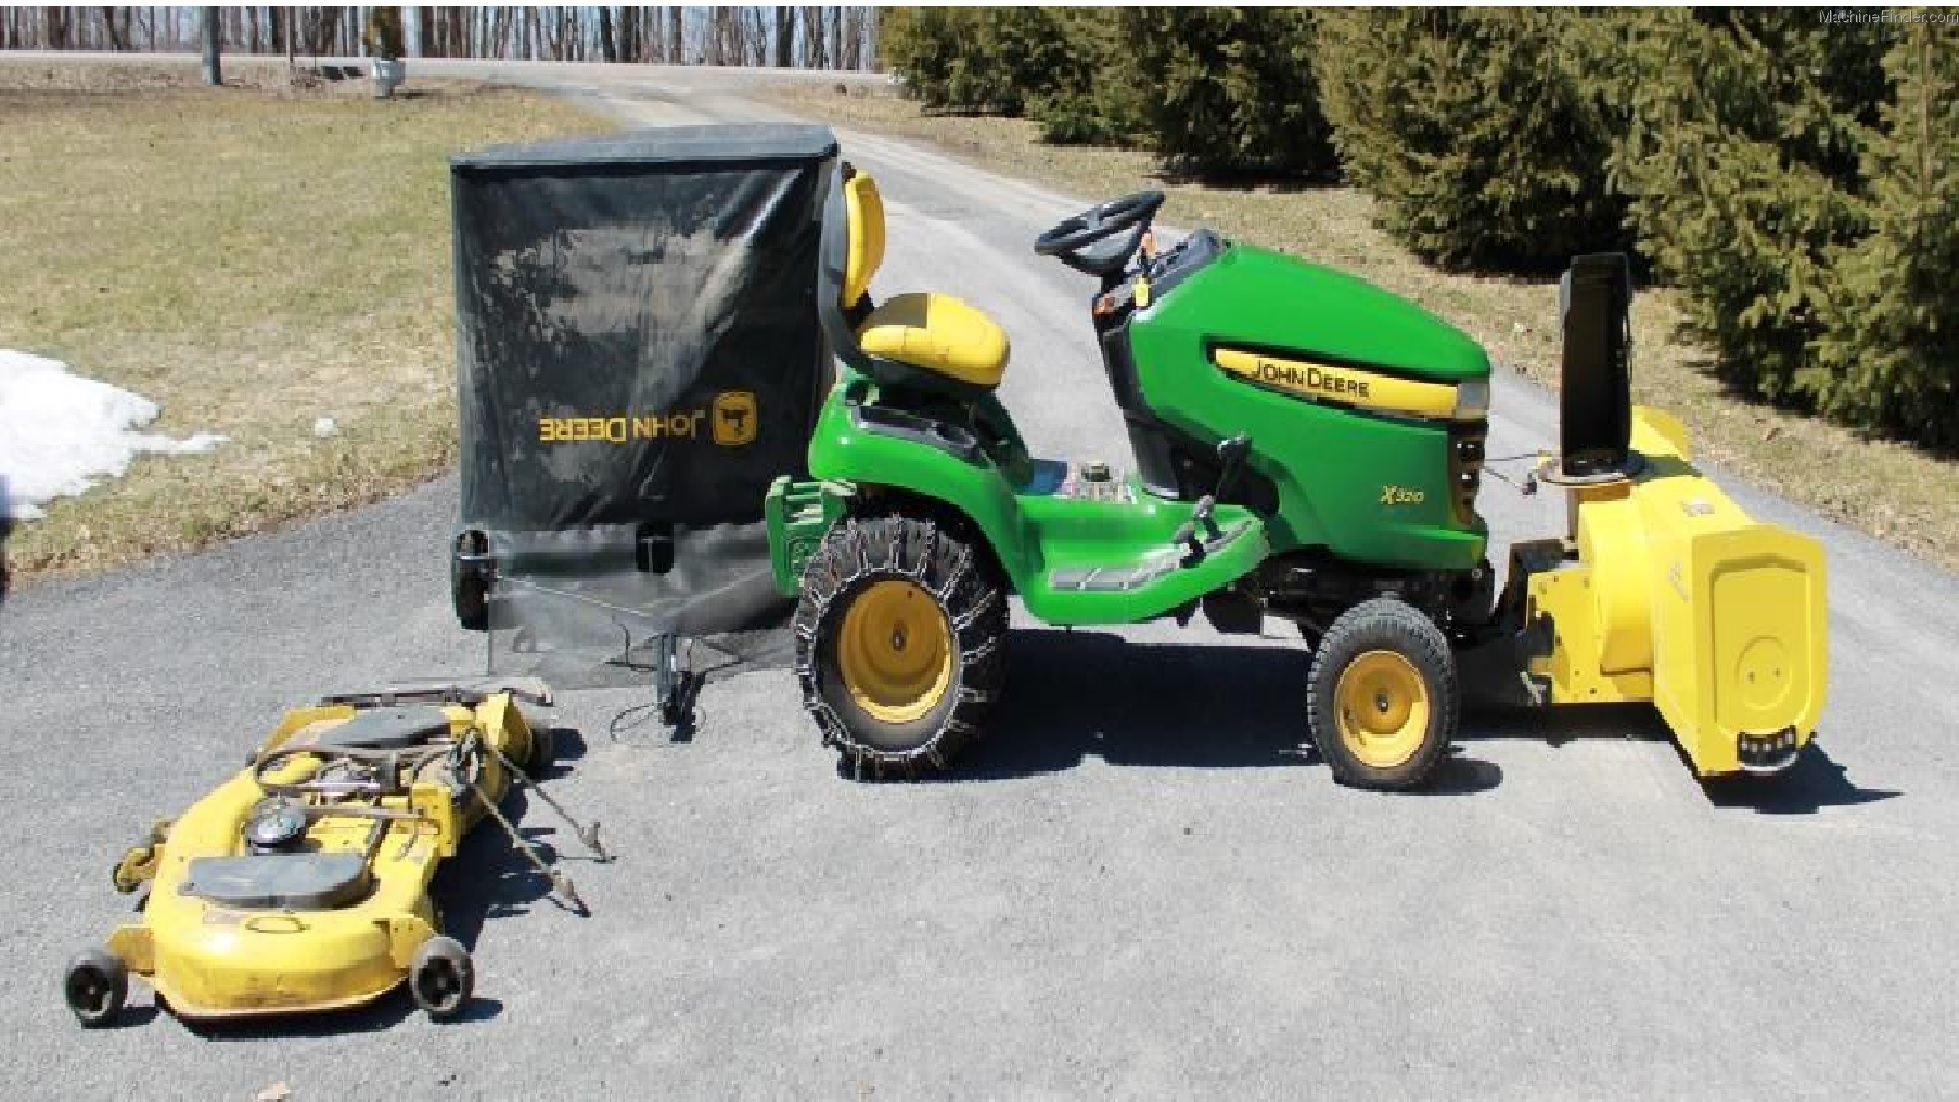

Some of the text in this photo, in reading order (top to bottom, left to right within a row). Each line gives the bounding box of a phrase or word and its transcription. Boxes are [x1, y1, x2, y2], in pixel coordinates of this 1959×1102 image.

[1251, 360, 1370, 398] JOHN DEERE
[539, 409, 706, 442] JOHN DEERE
